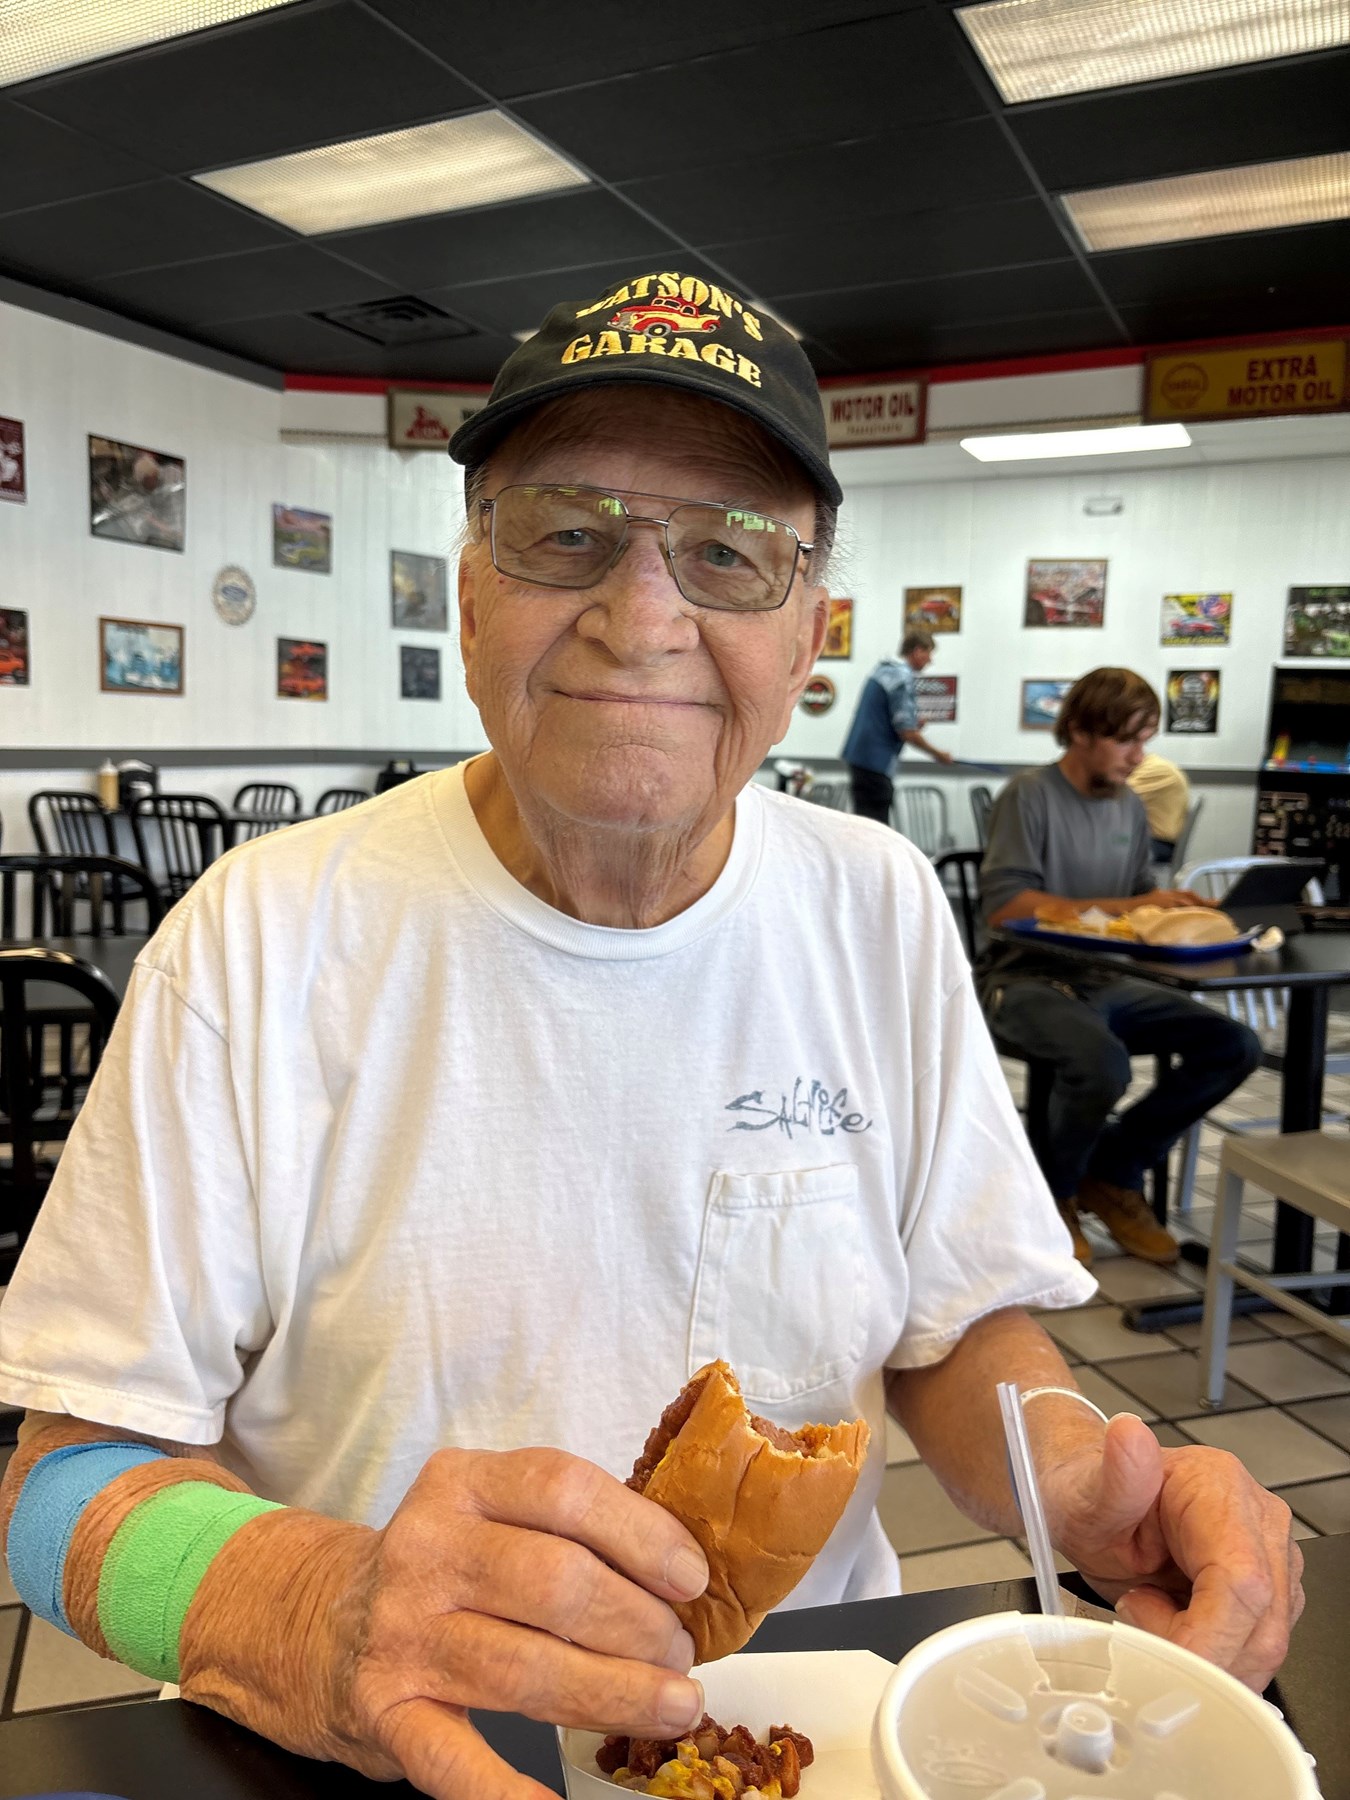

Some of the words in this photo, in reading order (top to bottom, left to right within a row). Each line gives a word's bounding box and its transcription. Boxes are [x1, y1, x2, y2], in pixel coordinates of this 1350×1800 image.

[561, 330, 762, 388] GARAGE
[1247, 355, 1318, 382] EXTRA
[830, 396, 883, 423] MOTOR
[888, 391, 914, 417] OIL
[1227, 382, 1297, 407] MOTOR
[1303, 378, 1335, 401] OIL
